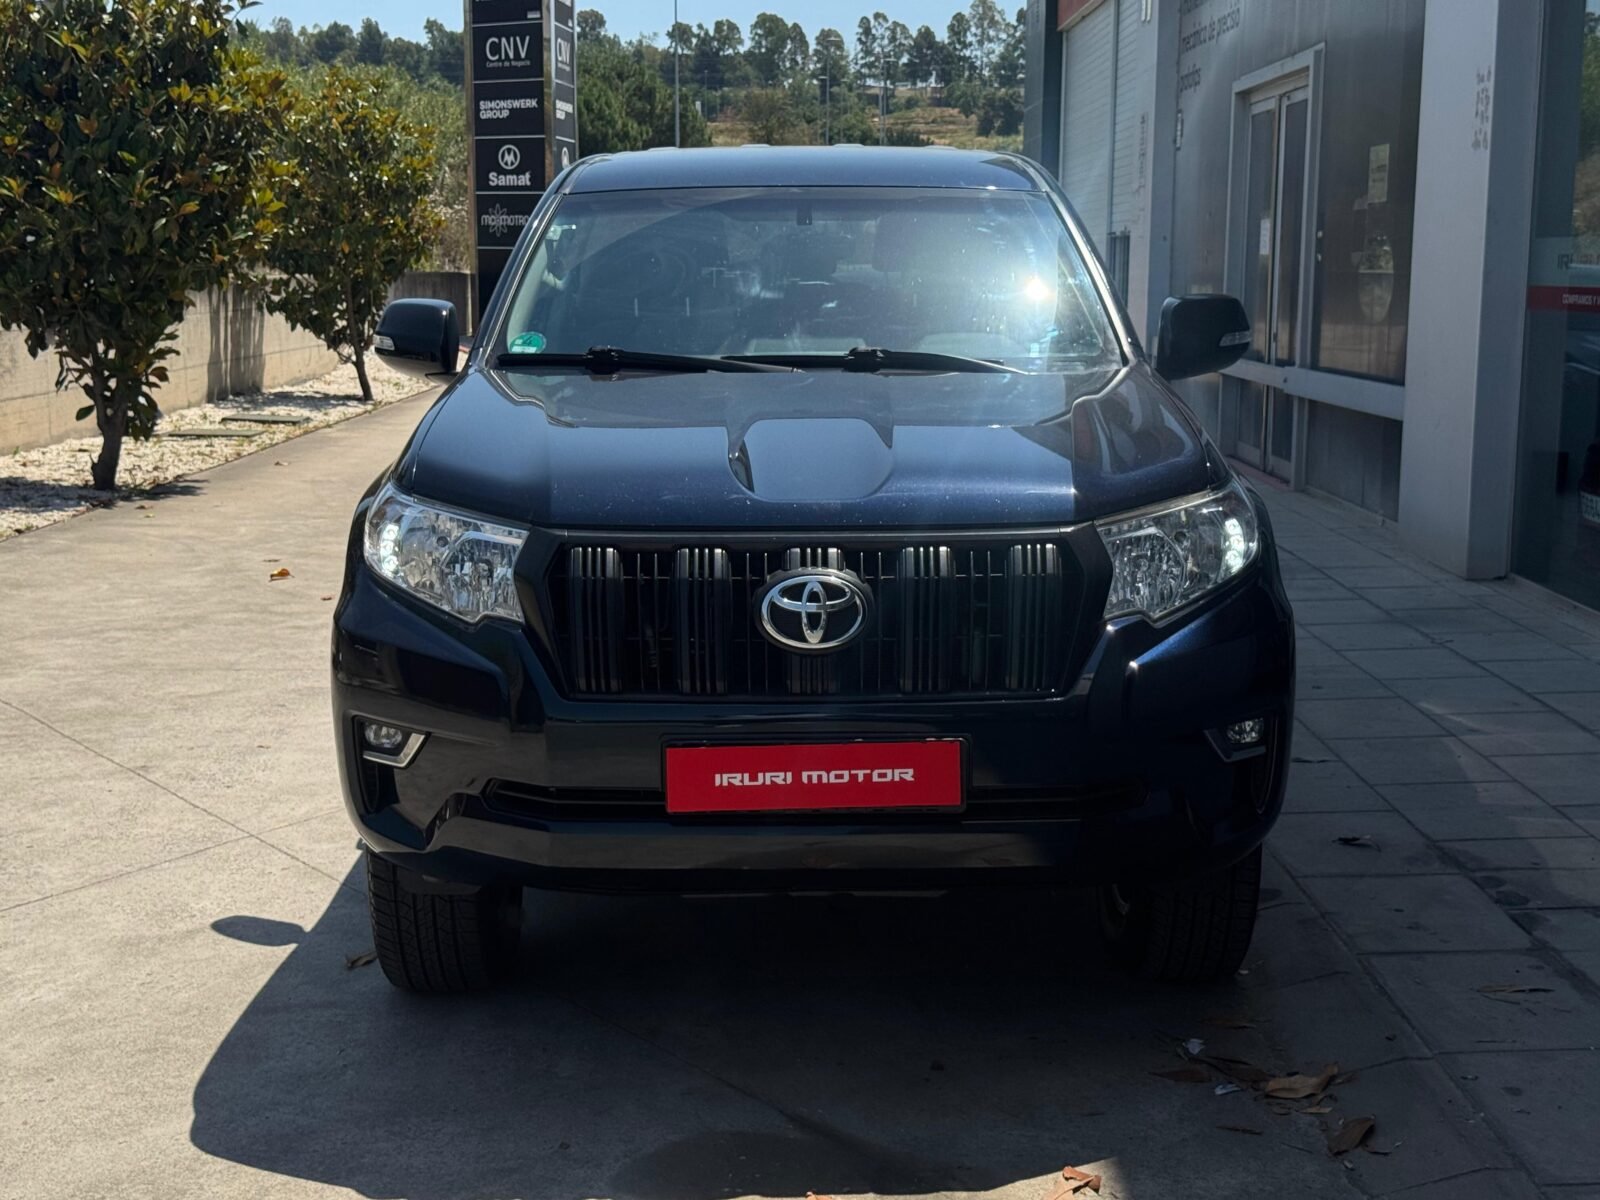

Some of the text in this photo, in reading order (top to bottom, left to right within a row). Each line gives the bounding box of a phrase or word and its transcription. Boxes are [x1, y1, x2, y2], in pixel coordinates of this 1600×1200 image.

[485, 35, 530, 61] CNV
[479, 98, 538, 110] SIMONSWERK
[479, 109, 510, 120] GROUP
[488, 171, 532, 186] Samat
[714, 768, 915, 787] IRURI MOTOR
